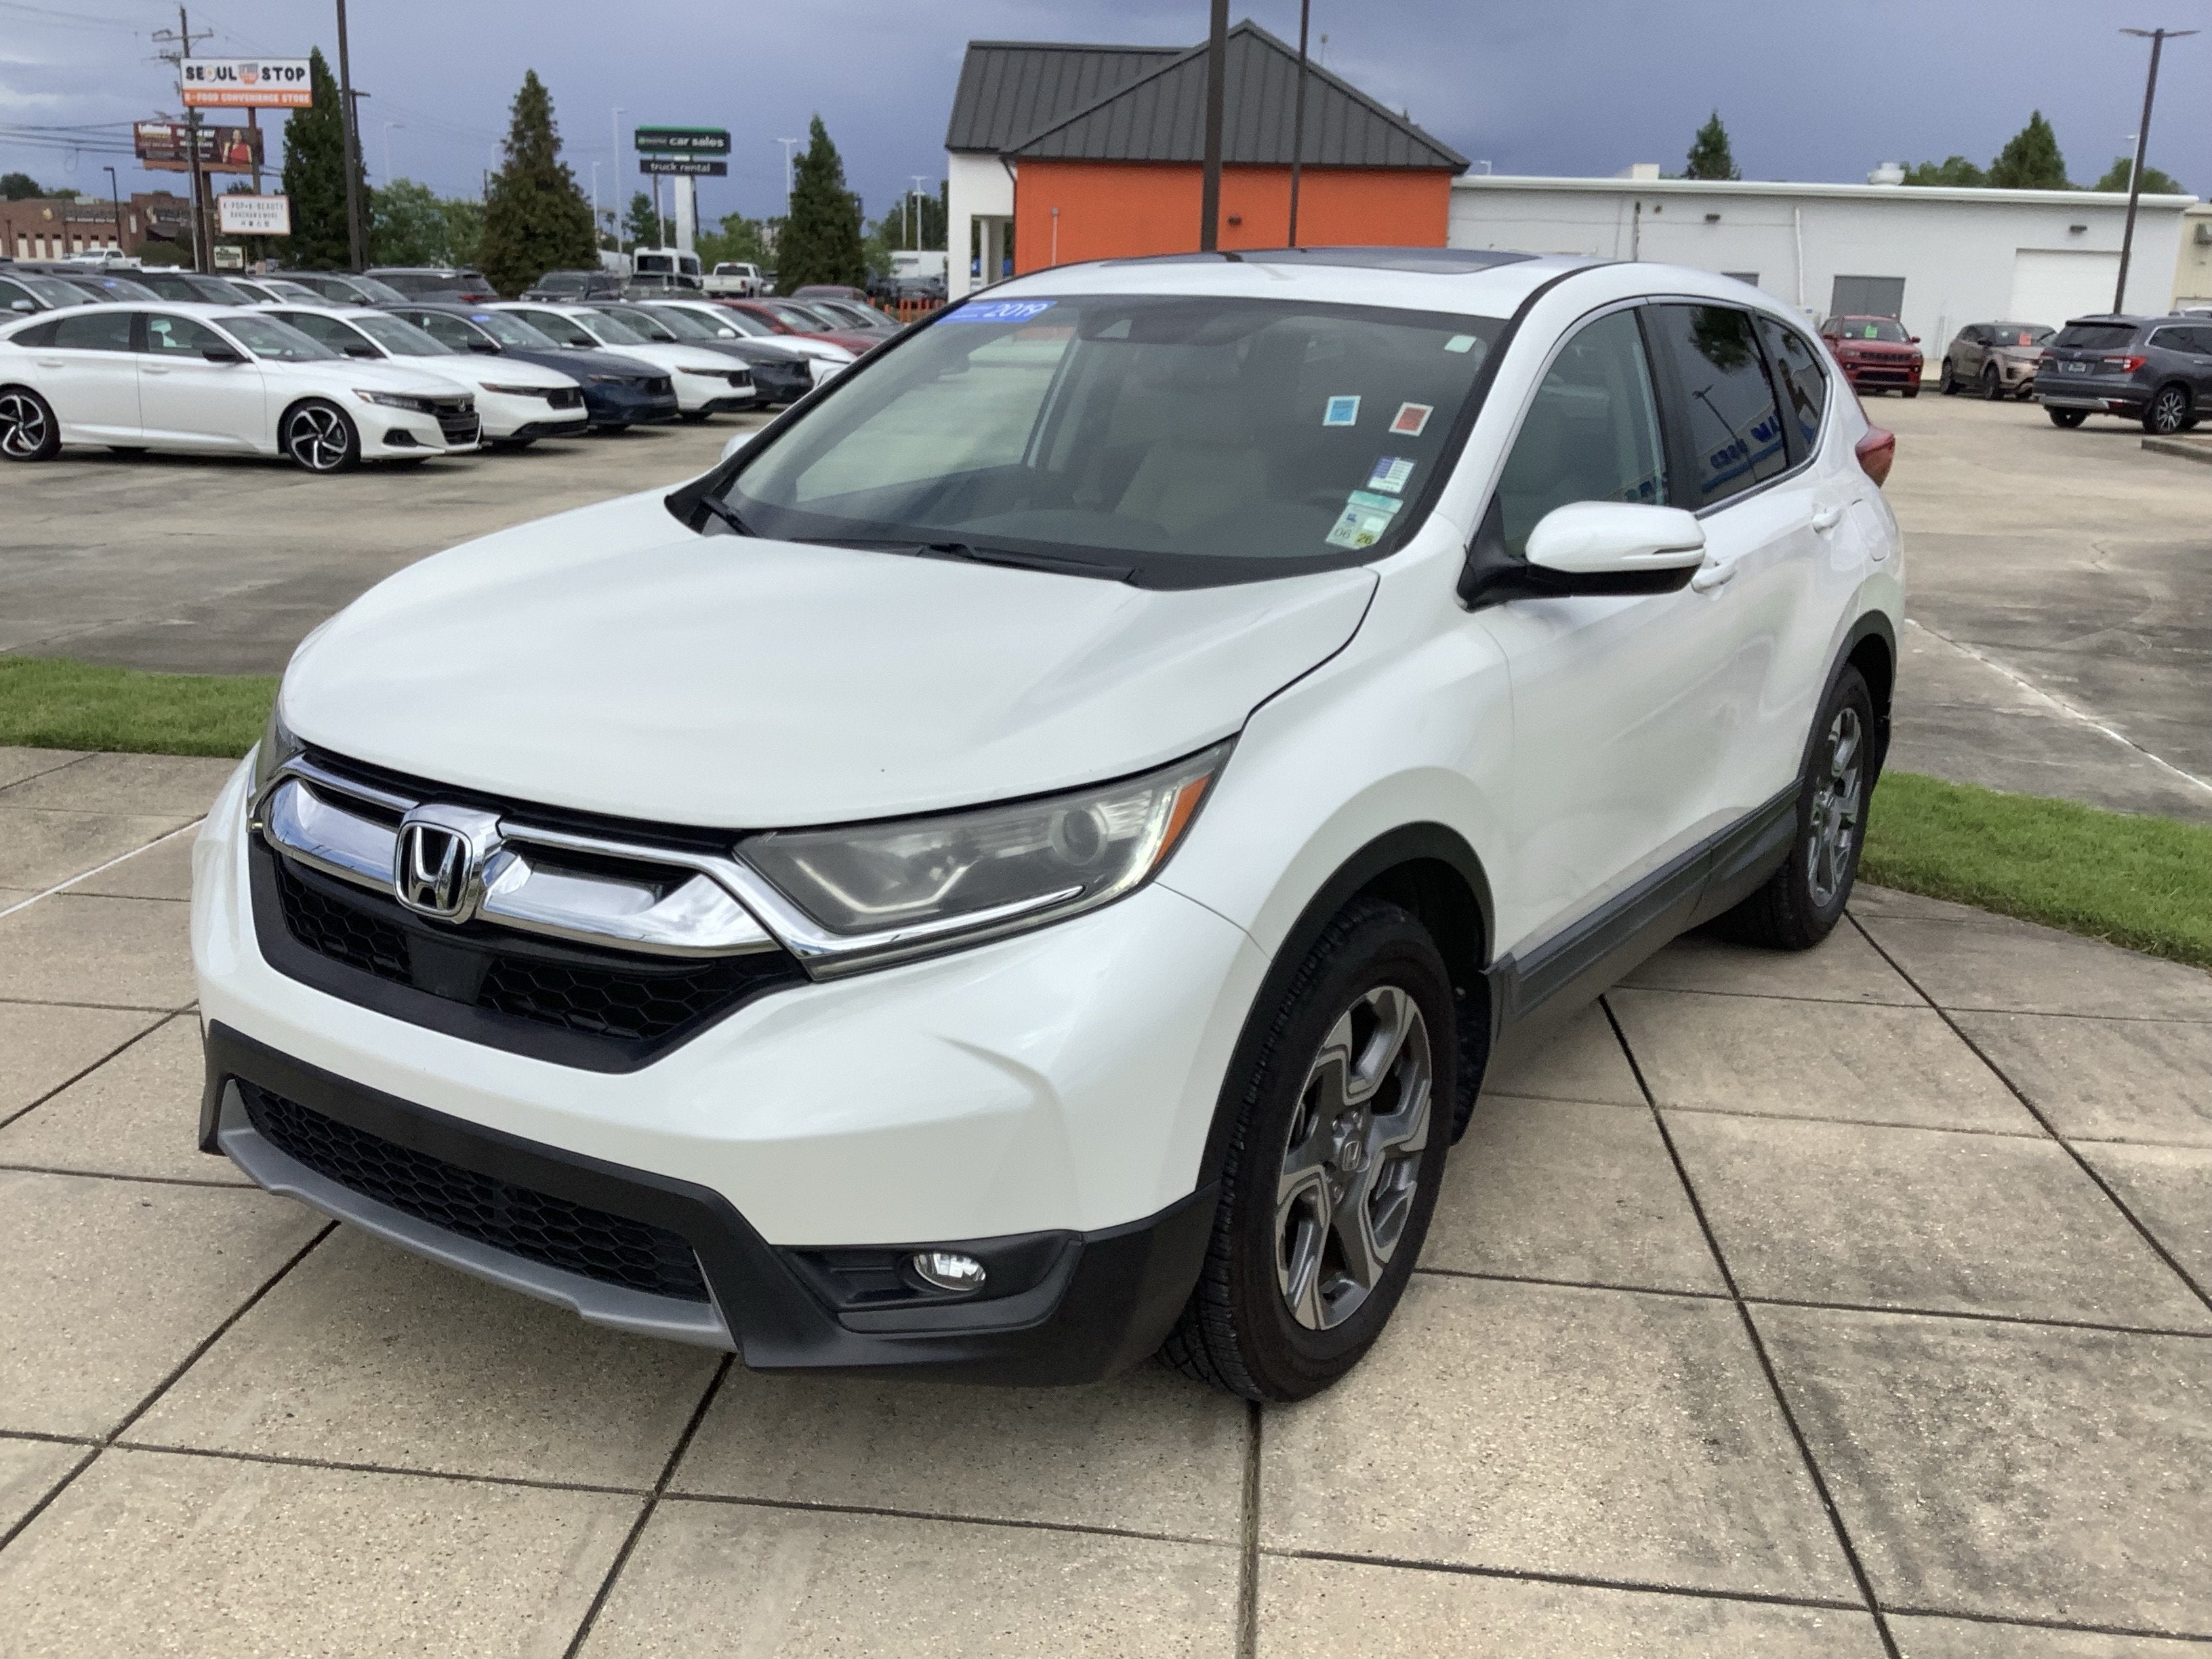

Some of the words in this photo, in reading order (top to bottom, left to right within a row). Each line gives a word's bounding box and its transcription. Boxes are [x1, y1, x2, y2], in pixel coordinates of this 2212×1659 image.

[262, 66, 306, 81] STOP
[669, 137, 689, 146] car
[692, 136, 724, 148] sales
[650, 163, 677, 172] truck
[680, 163, 711, 173] rental
[982, 303, 1048, 318] 2019
[1335, 527, 1351, 539] 06
[1357, 533, 1372, 544] 26
